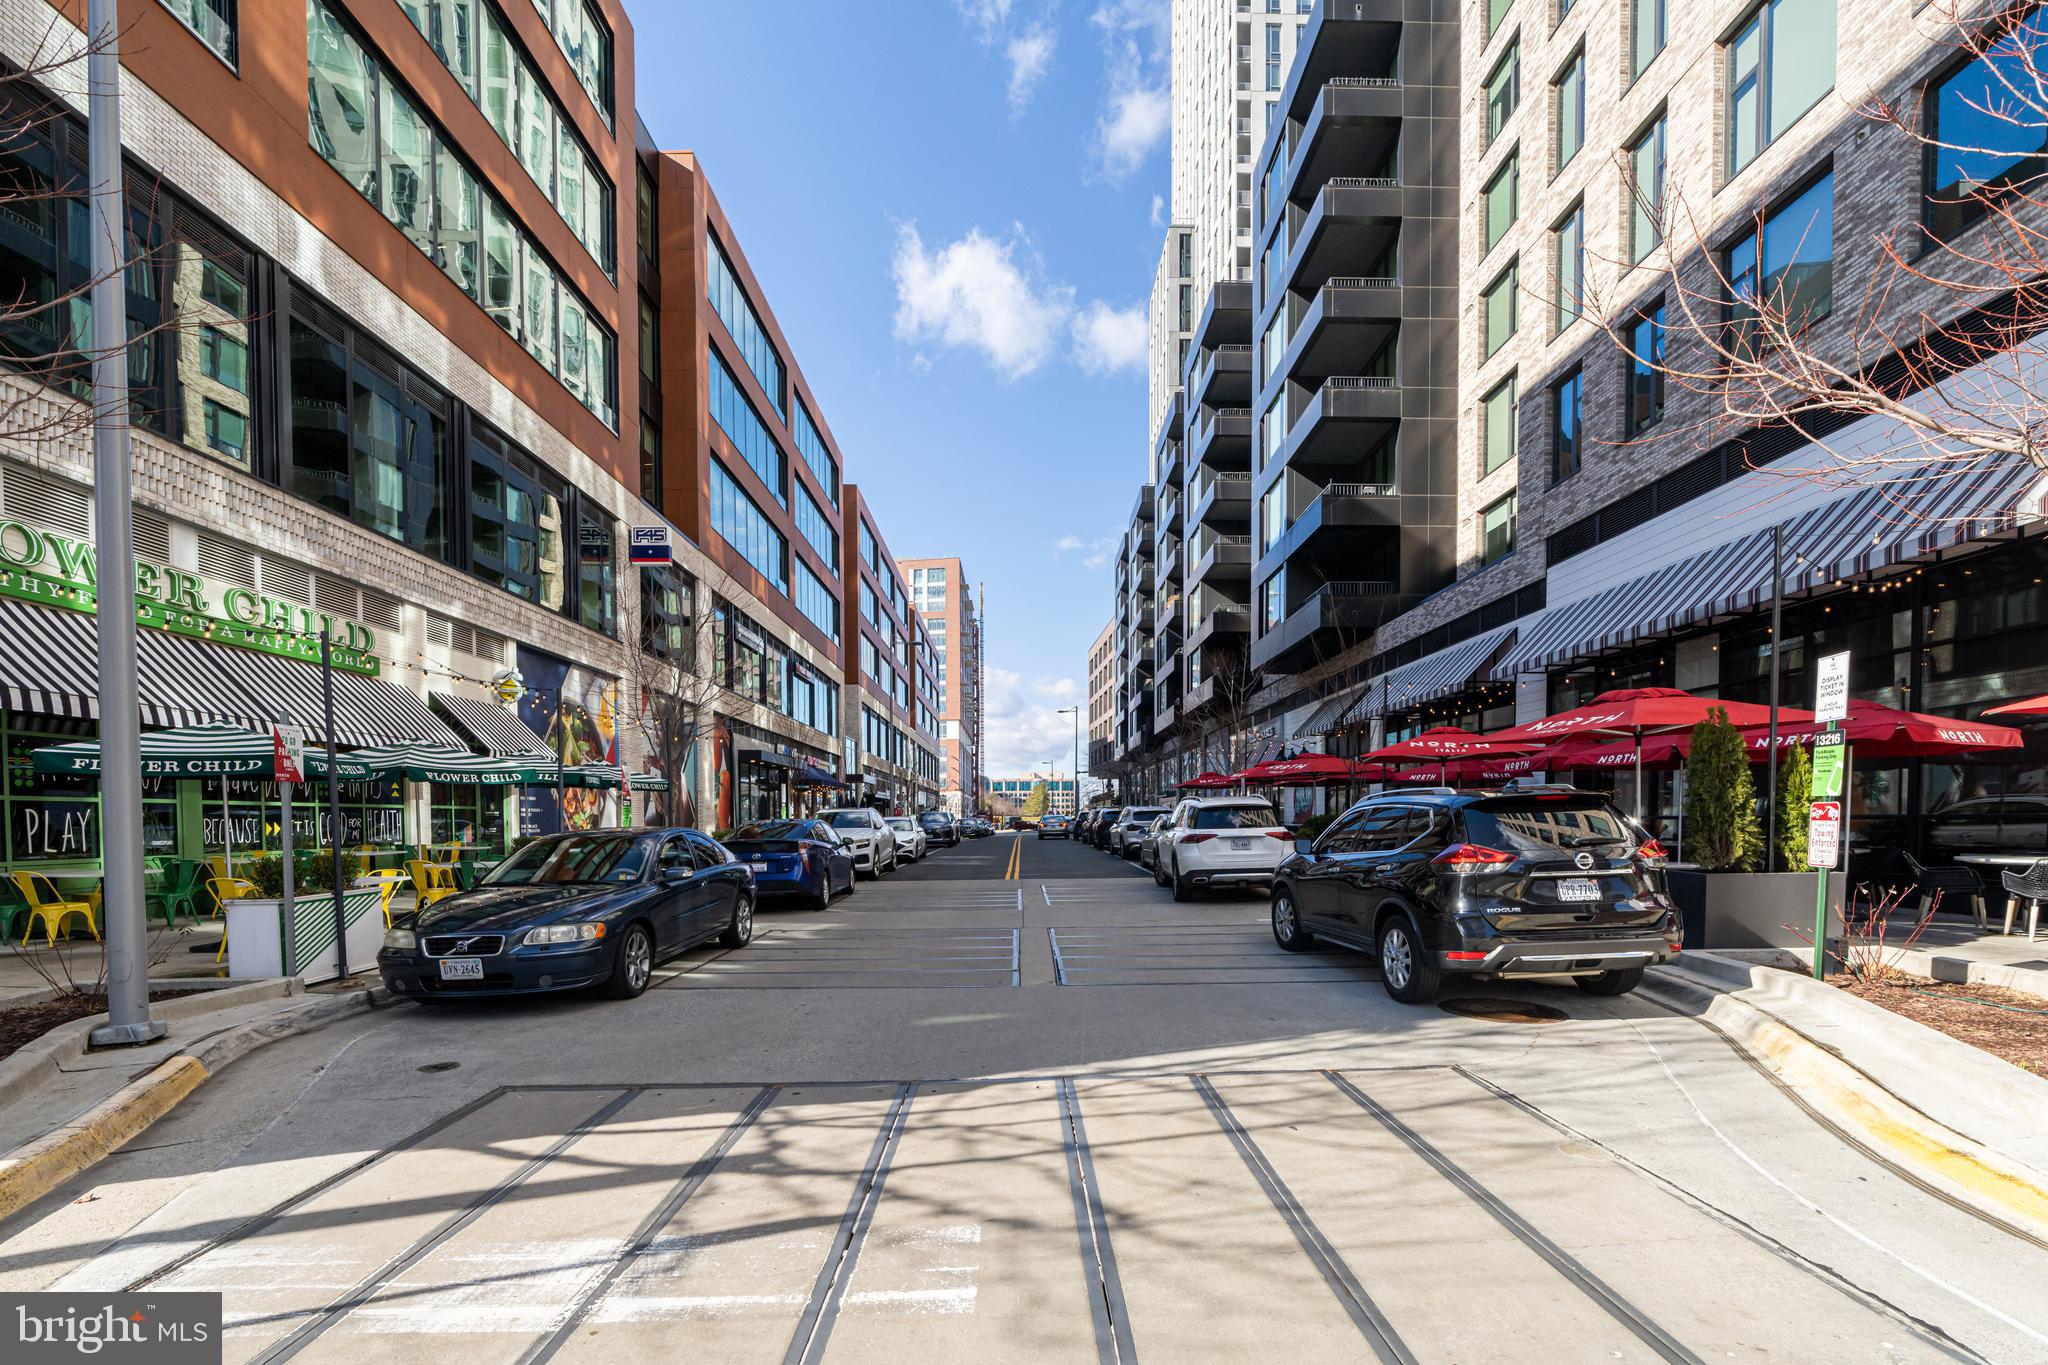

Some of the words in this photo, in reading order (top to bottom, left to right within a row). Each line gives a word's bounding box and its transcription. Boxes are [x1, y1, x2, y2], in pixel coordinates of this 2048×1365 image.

[633, 526, 667, 543] F45
[78, 589, 153, 619] FD
[220, 624, 235, 639] A
[243, 630, 309, 655] HAPPY
[223, 587, 376, 652] CHILD
[1820, 682, 1838, 691] TICKET
[1821, 674, 1844, 684] DISPLAY
[1820, 688, 1844, 698] WINDOW
[1525, 711, 1625, 732] NORTH
[289, 736, 297, 746] GO
[1755, 733, 1817, 748] NORT
[1938, 729, 1986, 744] NORTH
[278, 747, 300, 758] PARKING
[1597, 753, 1637, 764] NORTH
[72, 758, 180, 773] FLER
[187, 759, 263, 772] CHILD
[1504, 760, 1530, 772] NORTH
[425, 771, 480, 783] FLOWER
[481, 773, 522, 783] CHILD
[1409, 773, 1437, 781] NORTH
[25, 808, 91, 854] PLAY
[304, 819, 315, 837] IS
[348, 818, 362, 829] FOR
[366, 809, 402, 842] HEALTH
[203, 818, 260, 845] BECAUSE
